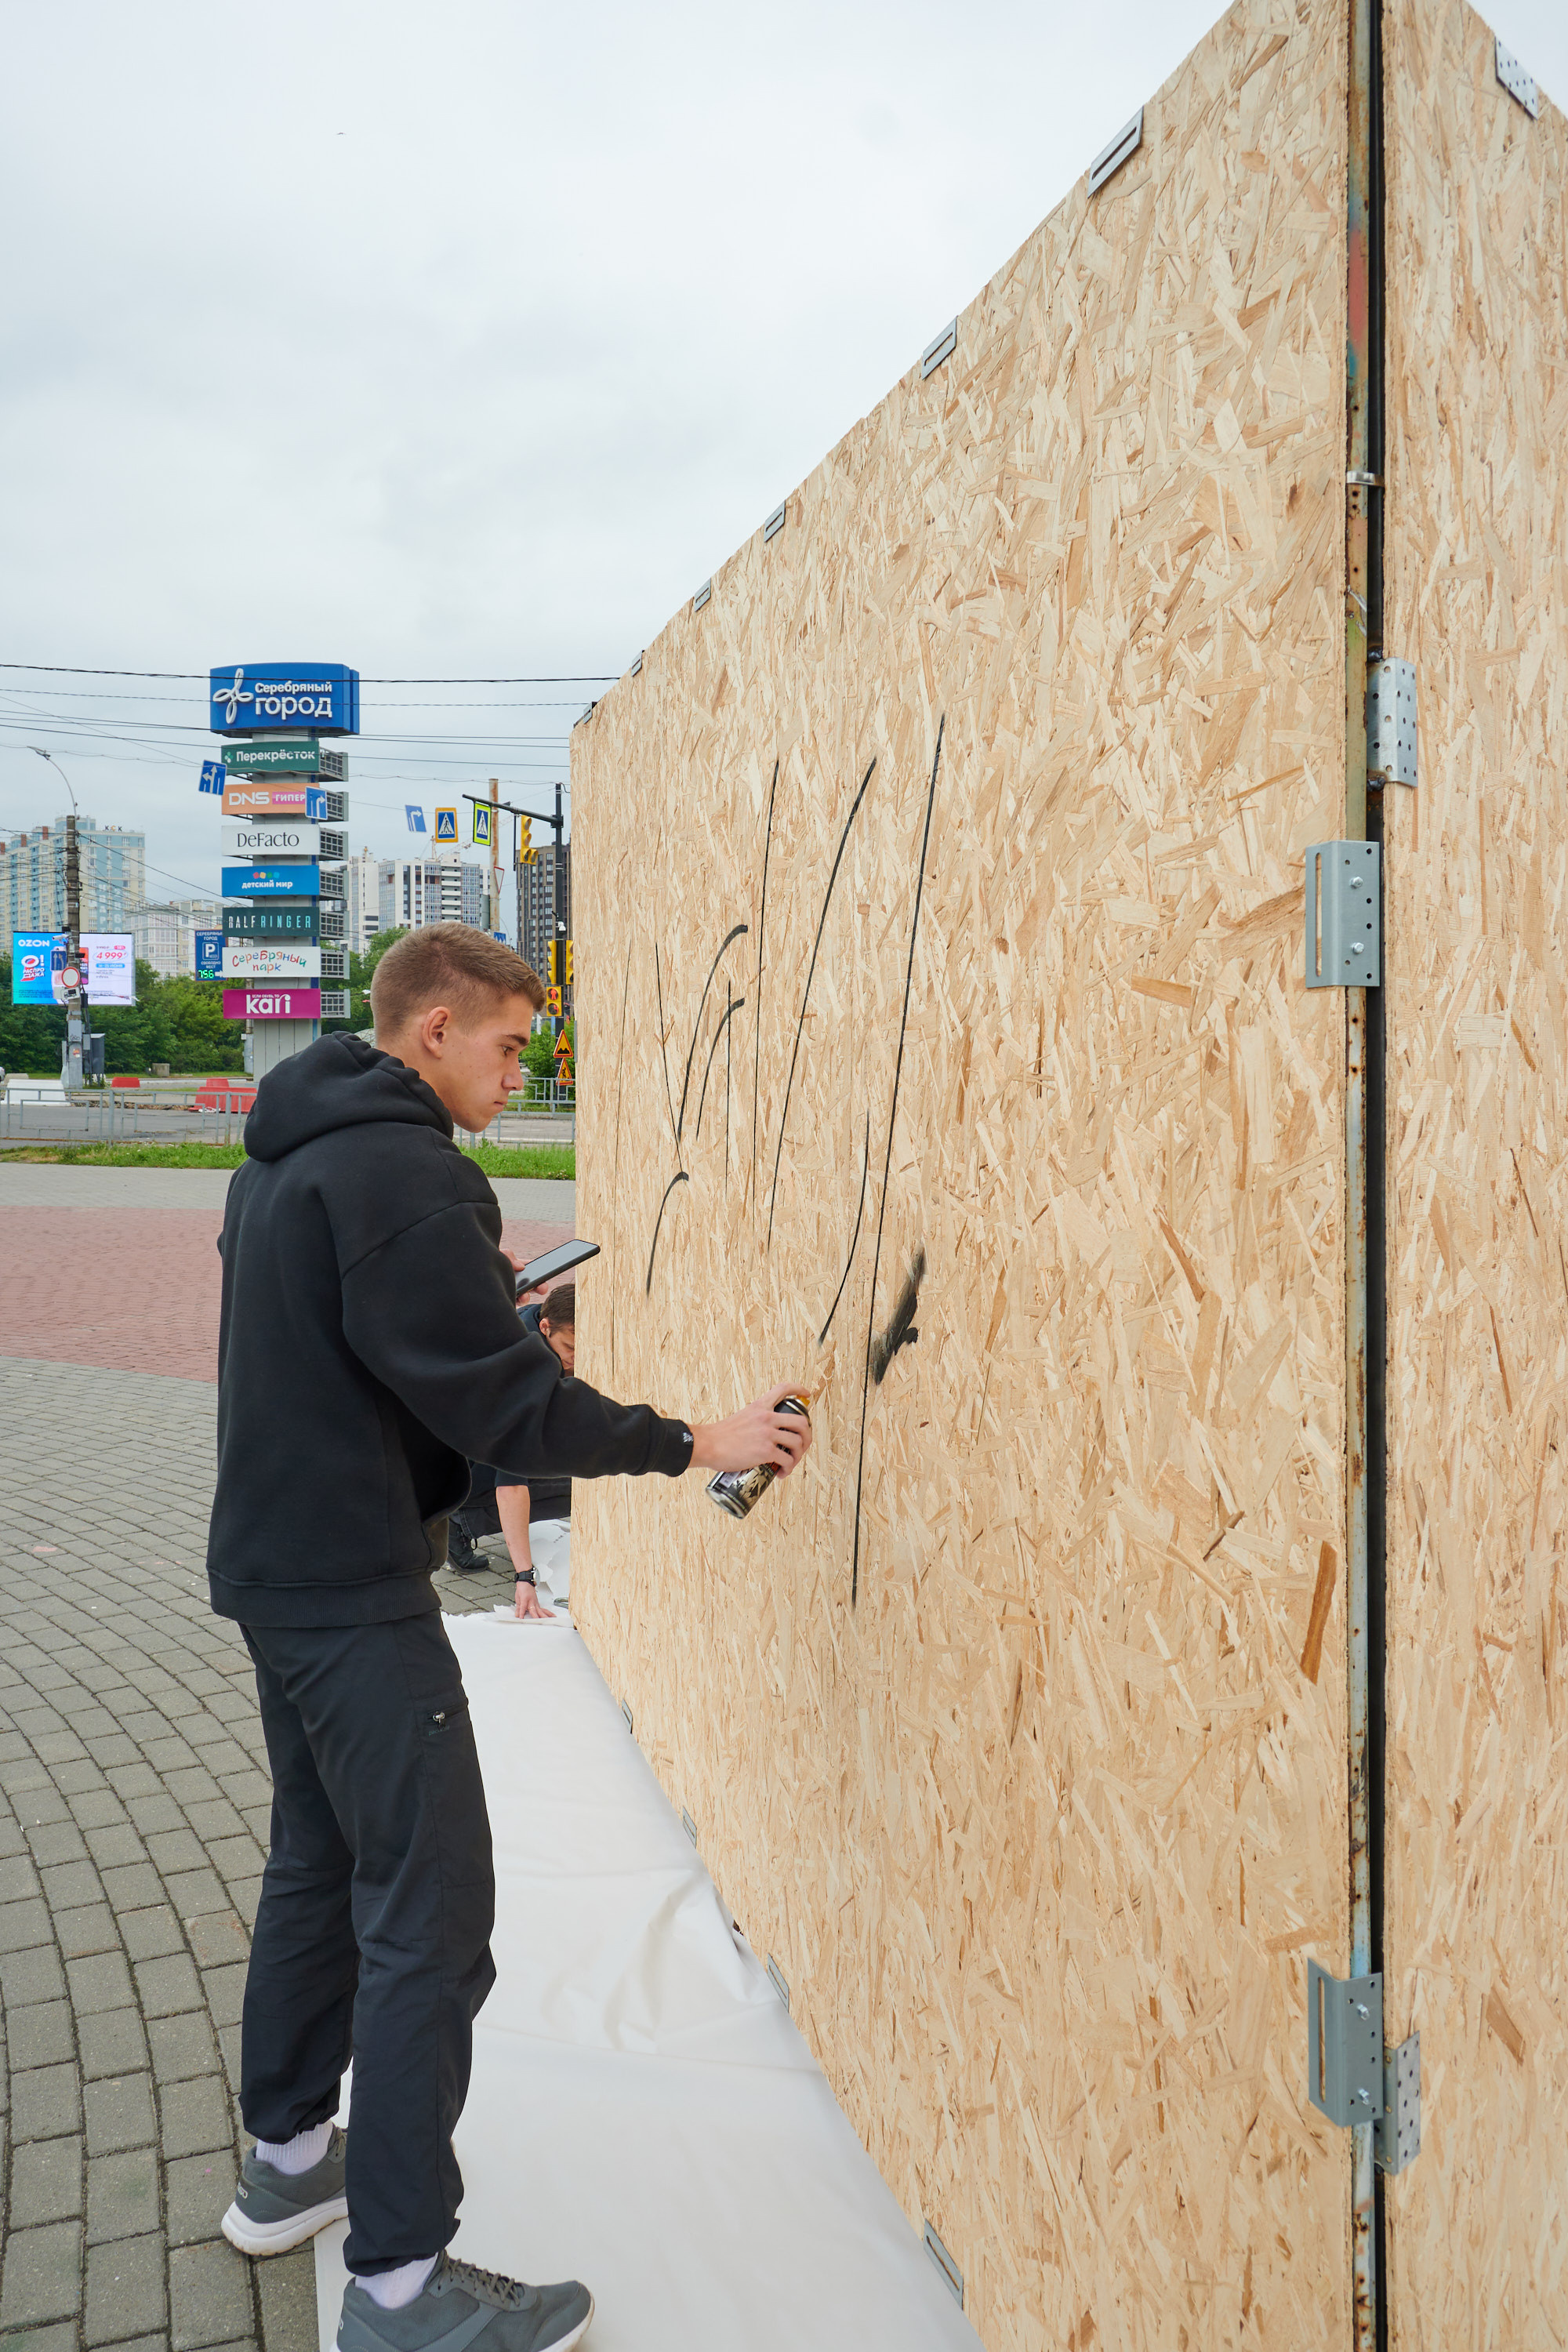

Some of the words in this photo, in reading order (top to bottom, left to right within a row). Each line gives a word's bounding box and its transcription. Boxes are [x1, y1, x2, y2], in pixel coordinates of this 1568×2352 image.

[255, 681, 332, 695] Серебряный
[236, 749, 315, 763] Перекрёсток
[228, 792, 270, 806] DNS
[275, 793, 306, 802] ГИПЕР
[237, 832, 299, 848] DeFacto
[241, 880, 274, 889] детский
[228, 915, 256, 929] RALF
[260, 915, 311, 928] RINGER
[252, 963, 281, 974] парк
[246, 993, 291, 1014] kari
